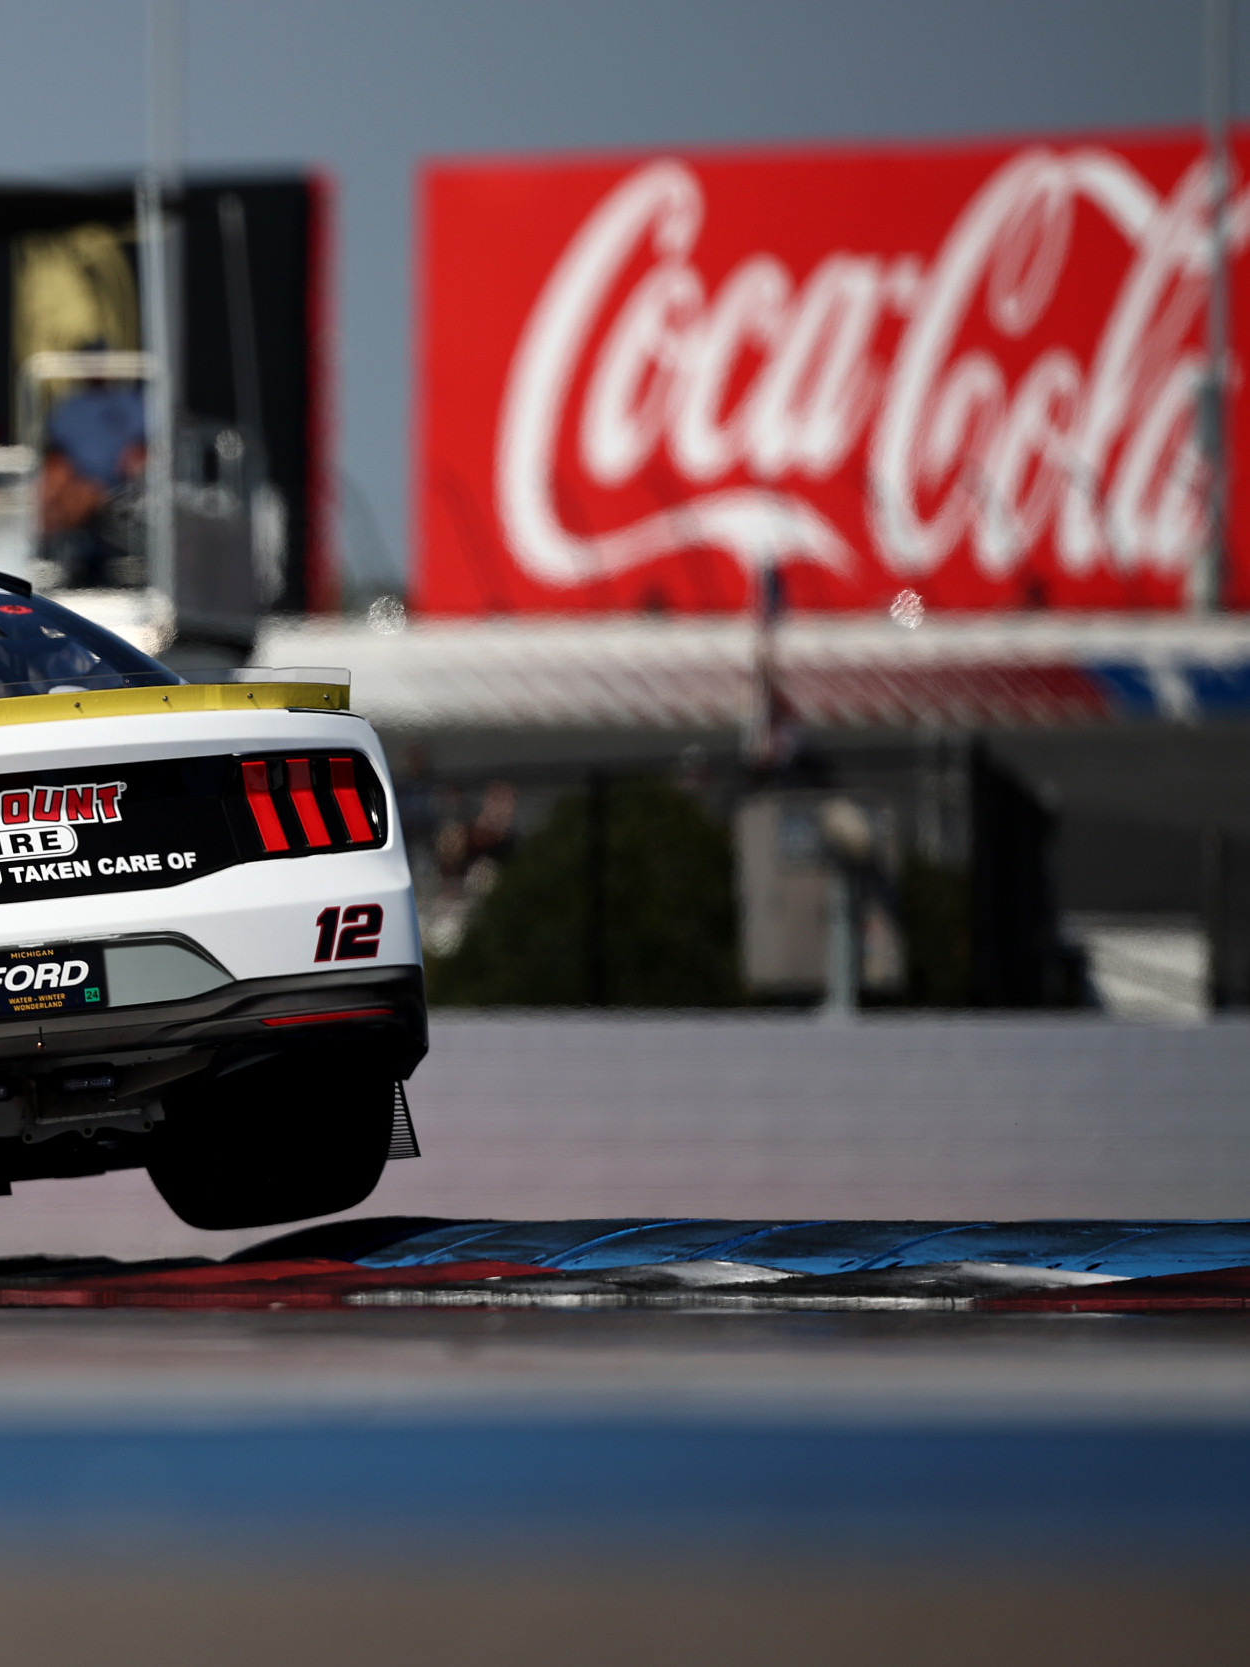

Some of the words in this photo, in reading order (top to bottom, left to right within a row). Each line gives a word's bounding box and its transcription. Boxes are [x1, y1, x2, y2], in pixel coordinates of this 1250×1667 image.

[496, 152, 1250, 588] Coca-Cola
[9, 860, 92, 884] TAKEN
[97, 853, 162, 876] CARE
[167, 852, 197, 869] OF
[314, 904, 384, 962] 12
[10, 949, 54, 959] MICHIGAN
[8, 995, 33, 1005] WATER
[39, 993, 66, 1002] WINTER
[86, 990, 99, 1000] 24
[13, 1001, 63, 1012] WONDERLAND
